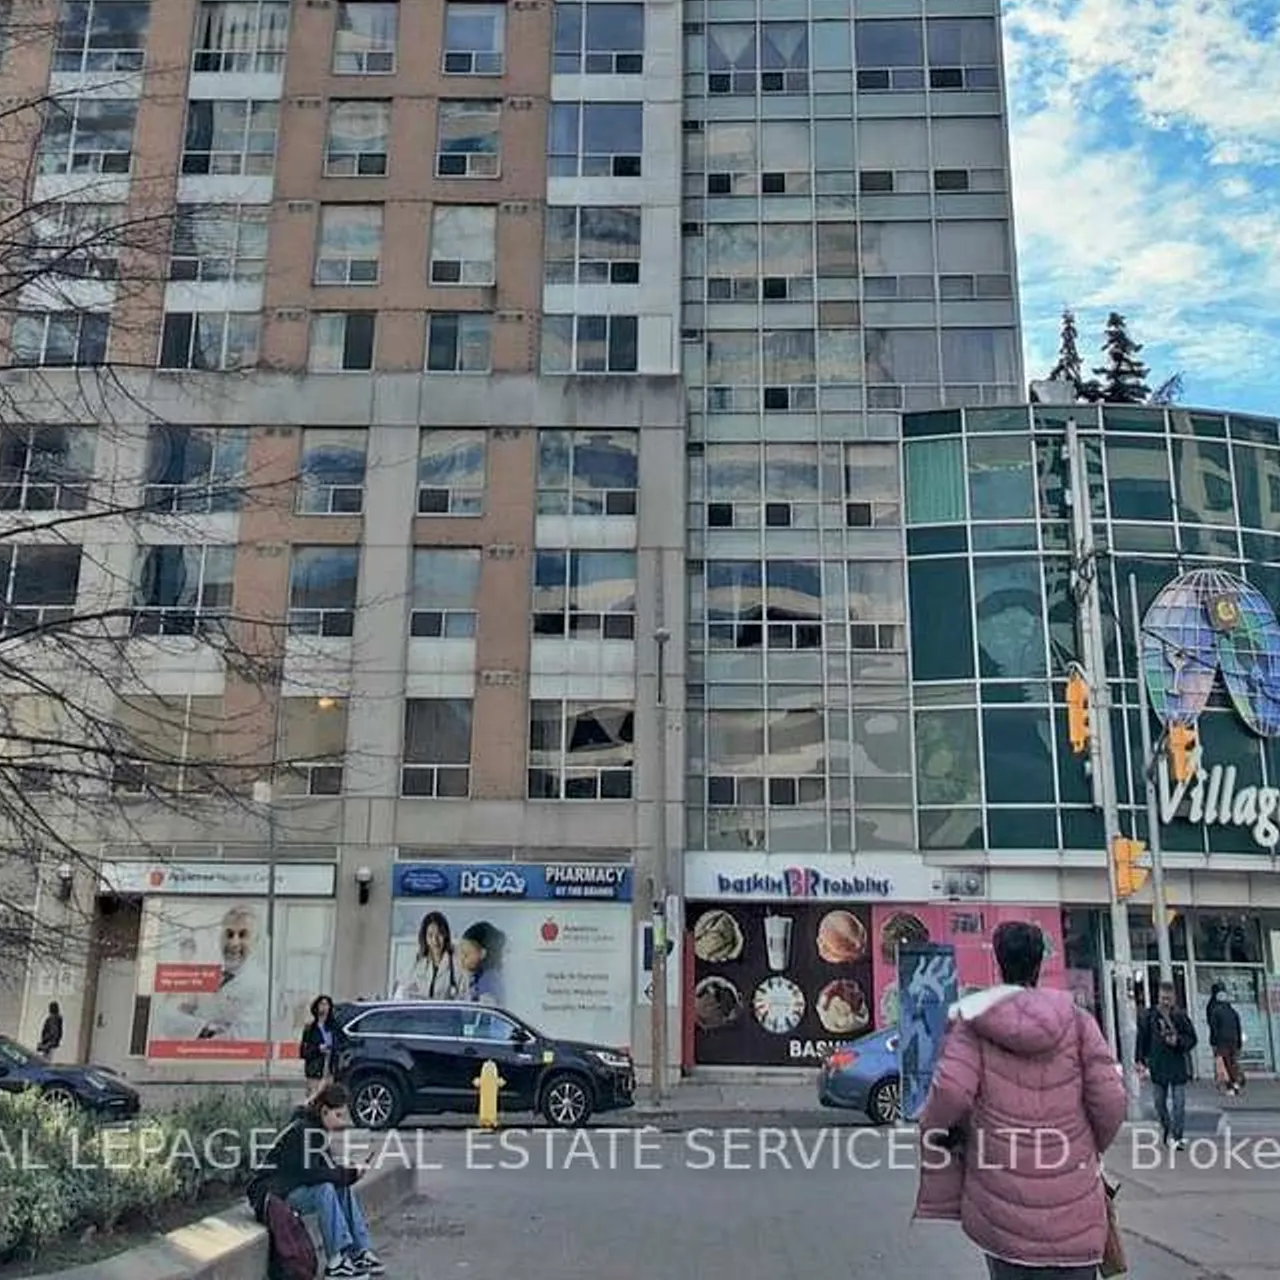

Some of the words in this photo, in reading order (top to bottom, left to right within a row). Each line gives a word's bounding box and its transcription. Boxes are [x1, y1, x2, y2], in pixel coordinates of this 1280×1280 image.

[545, 866, 626, 883] PHARMACY
[718, 873, 784, 894] baskin
[783, 866, 820, 897] BR
[822, 875, 890, 896] robbins
